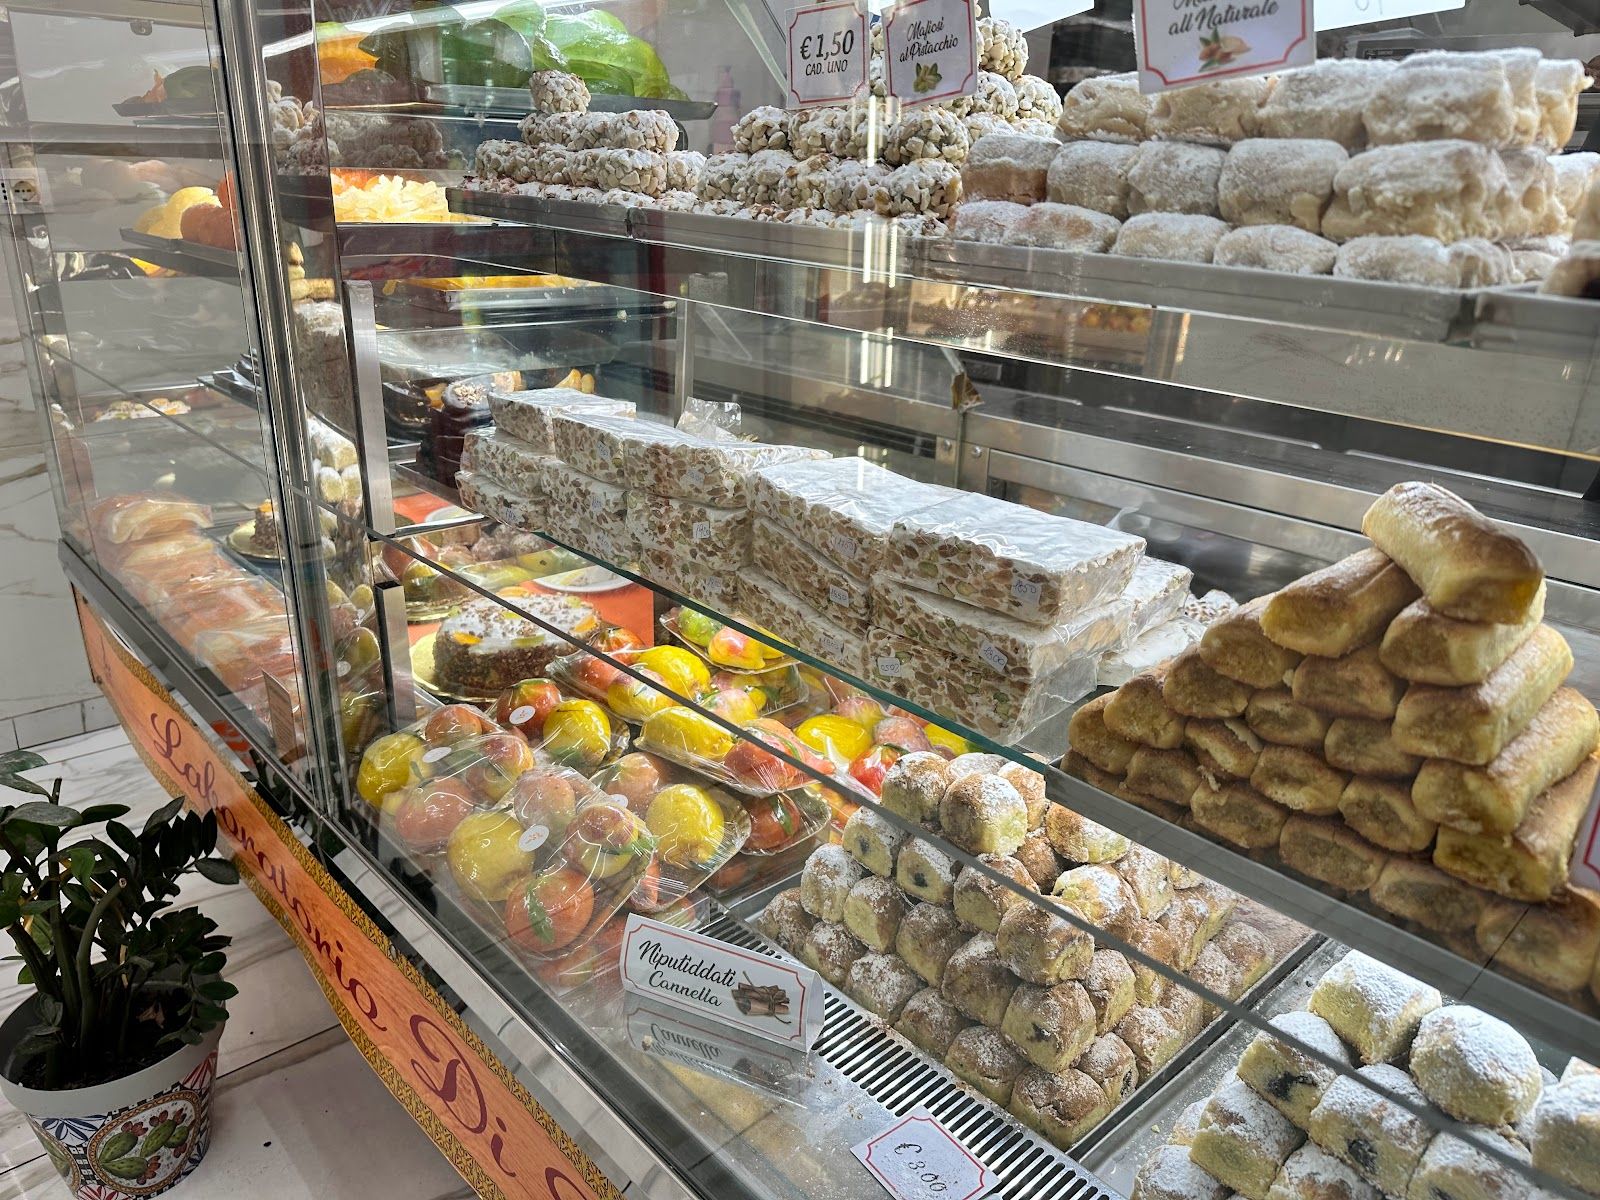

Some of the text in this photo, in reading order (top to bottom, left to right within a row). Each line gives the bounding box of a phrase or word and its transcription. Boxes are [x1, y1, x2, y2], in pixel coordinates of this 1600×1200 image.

[907, 17, 944, 42] Mafiosi
[1195, 0, 1279, 30] Naturale
[816, 29, 854, 61] 1,50
[899, 35, 959, 62] al Pistacchio
[805, 59, 848, 76] CAD. UNO
[150, 713, 517, 1177] Laboratorio Di
[638, 940, 736, 988] Niputiddati
[649, 970, 723, 1007] Cannella
